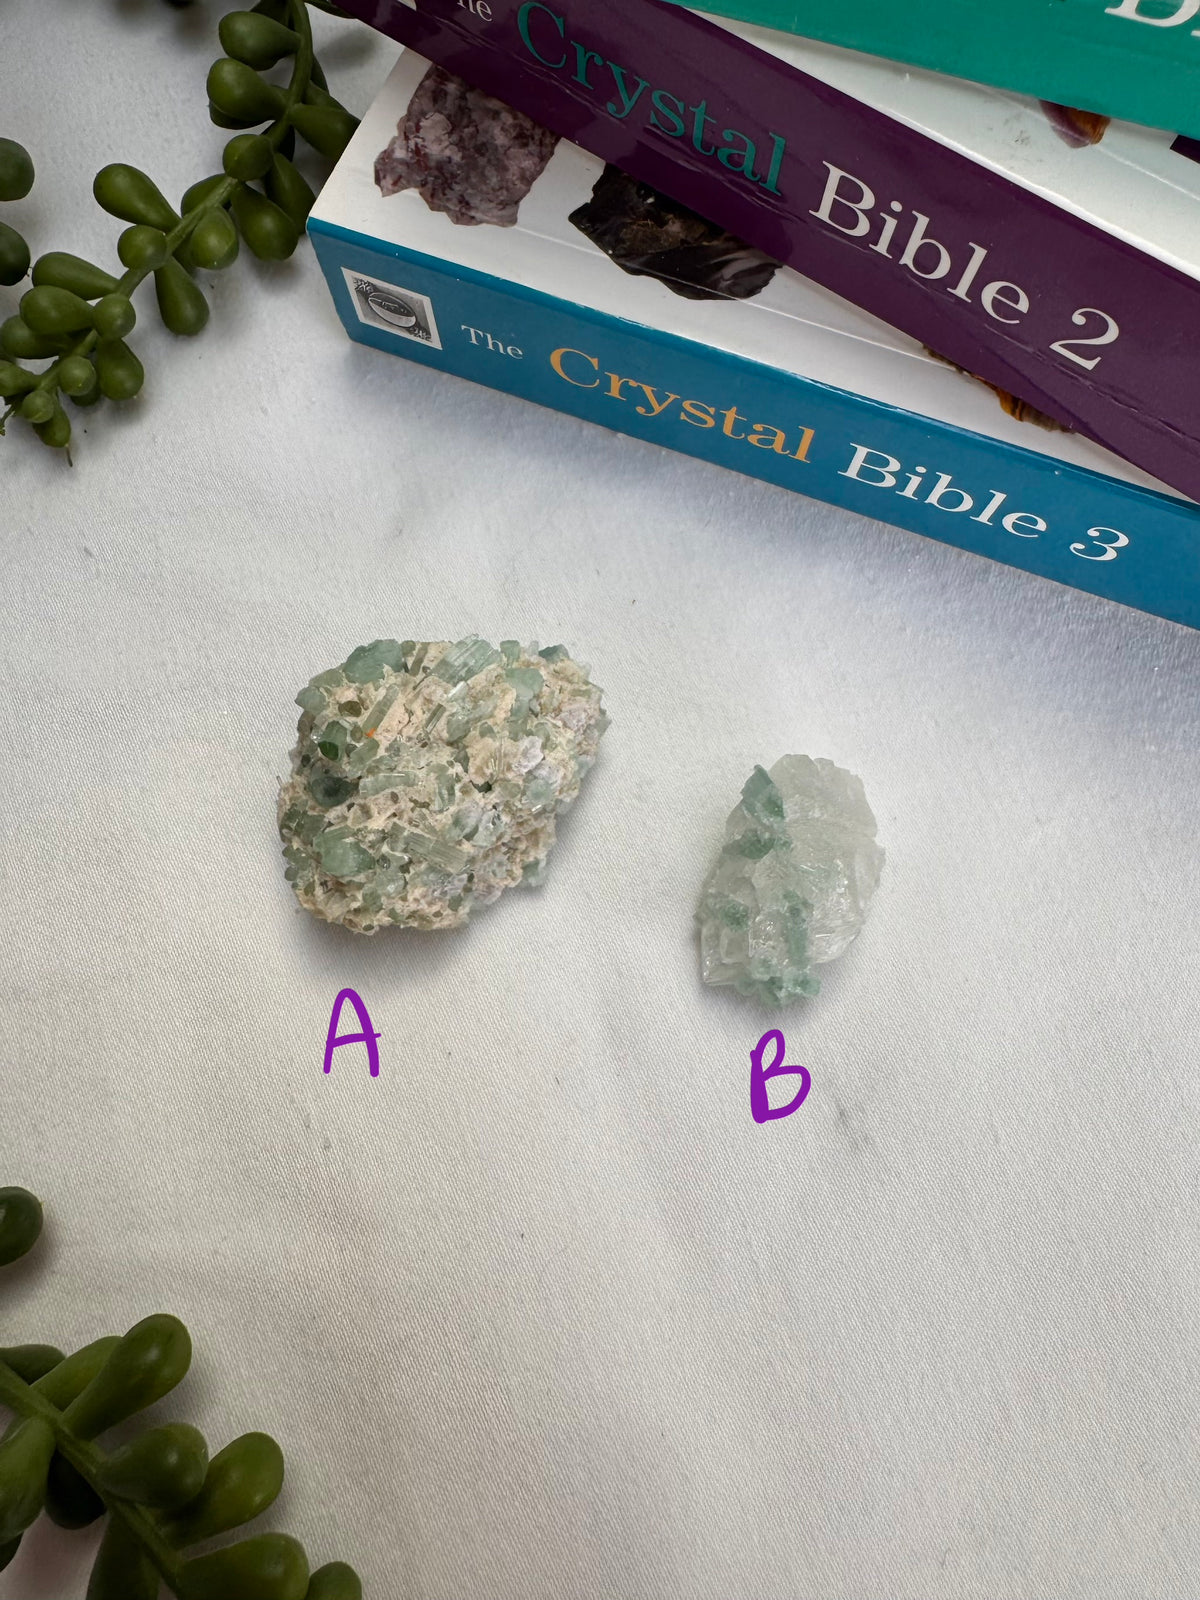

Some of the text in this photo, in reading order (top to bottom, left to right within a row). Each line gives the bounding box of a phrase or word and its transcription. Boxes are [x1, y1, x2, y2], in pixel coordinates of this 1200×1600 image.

[517, 1, 1120, 371] Crystal Bible 2
[461, 324, 1130, 561] The Crystal Bible 3
